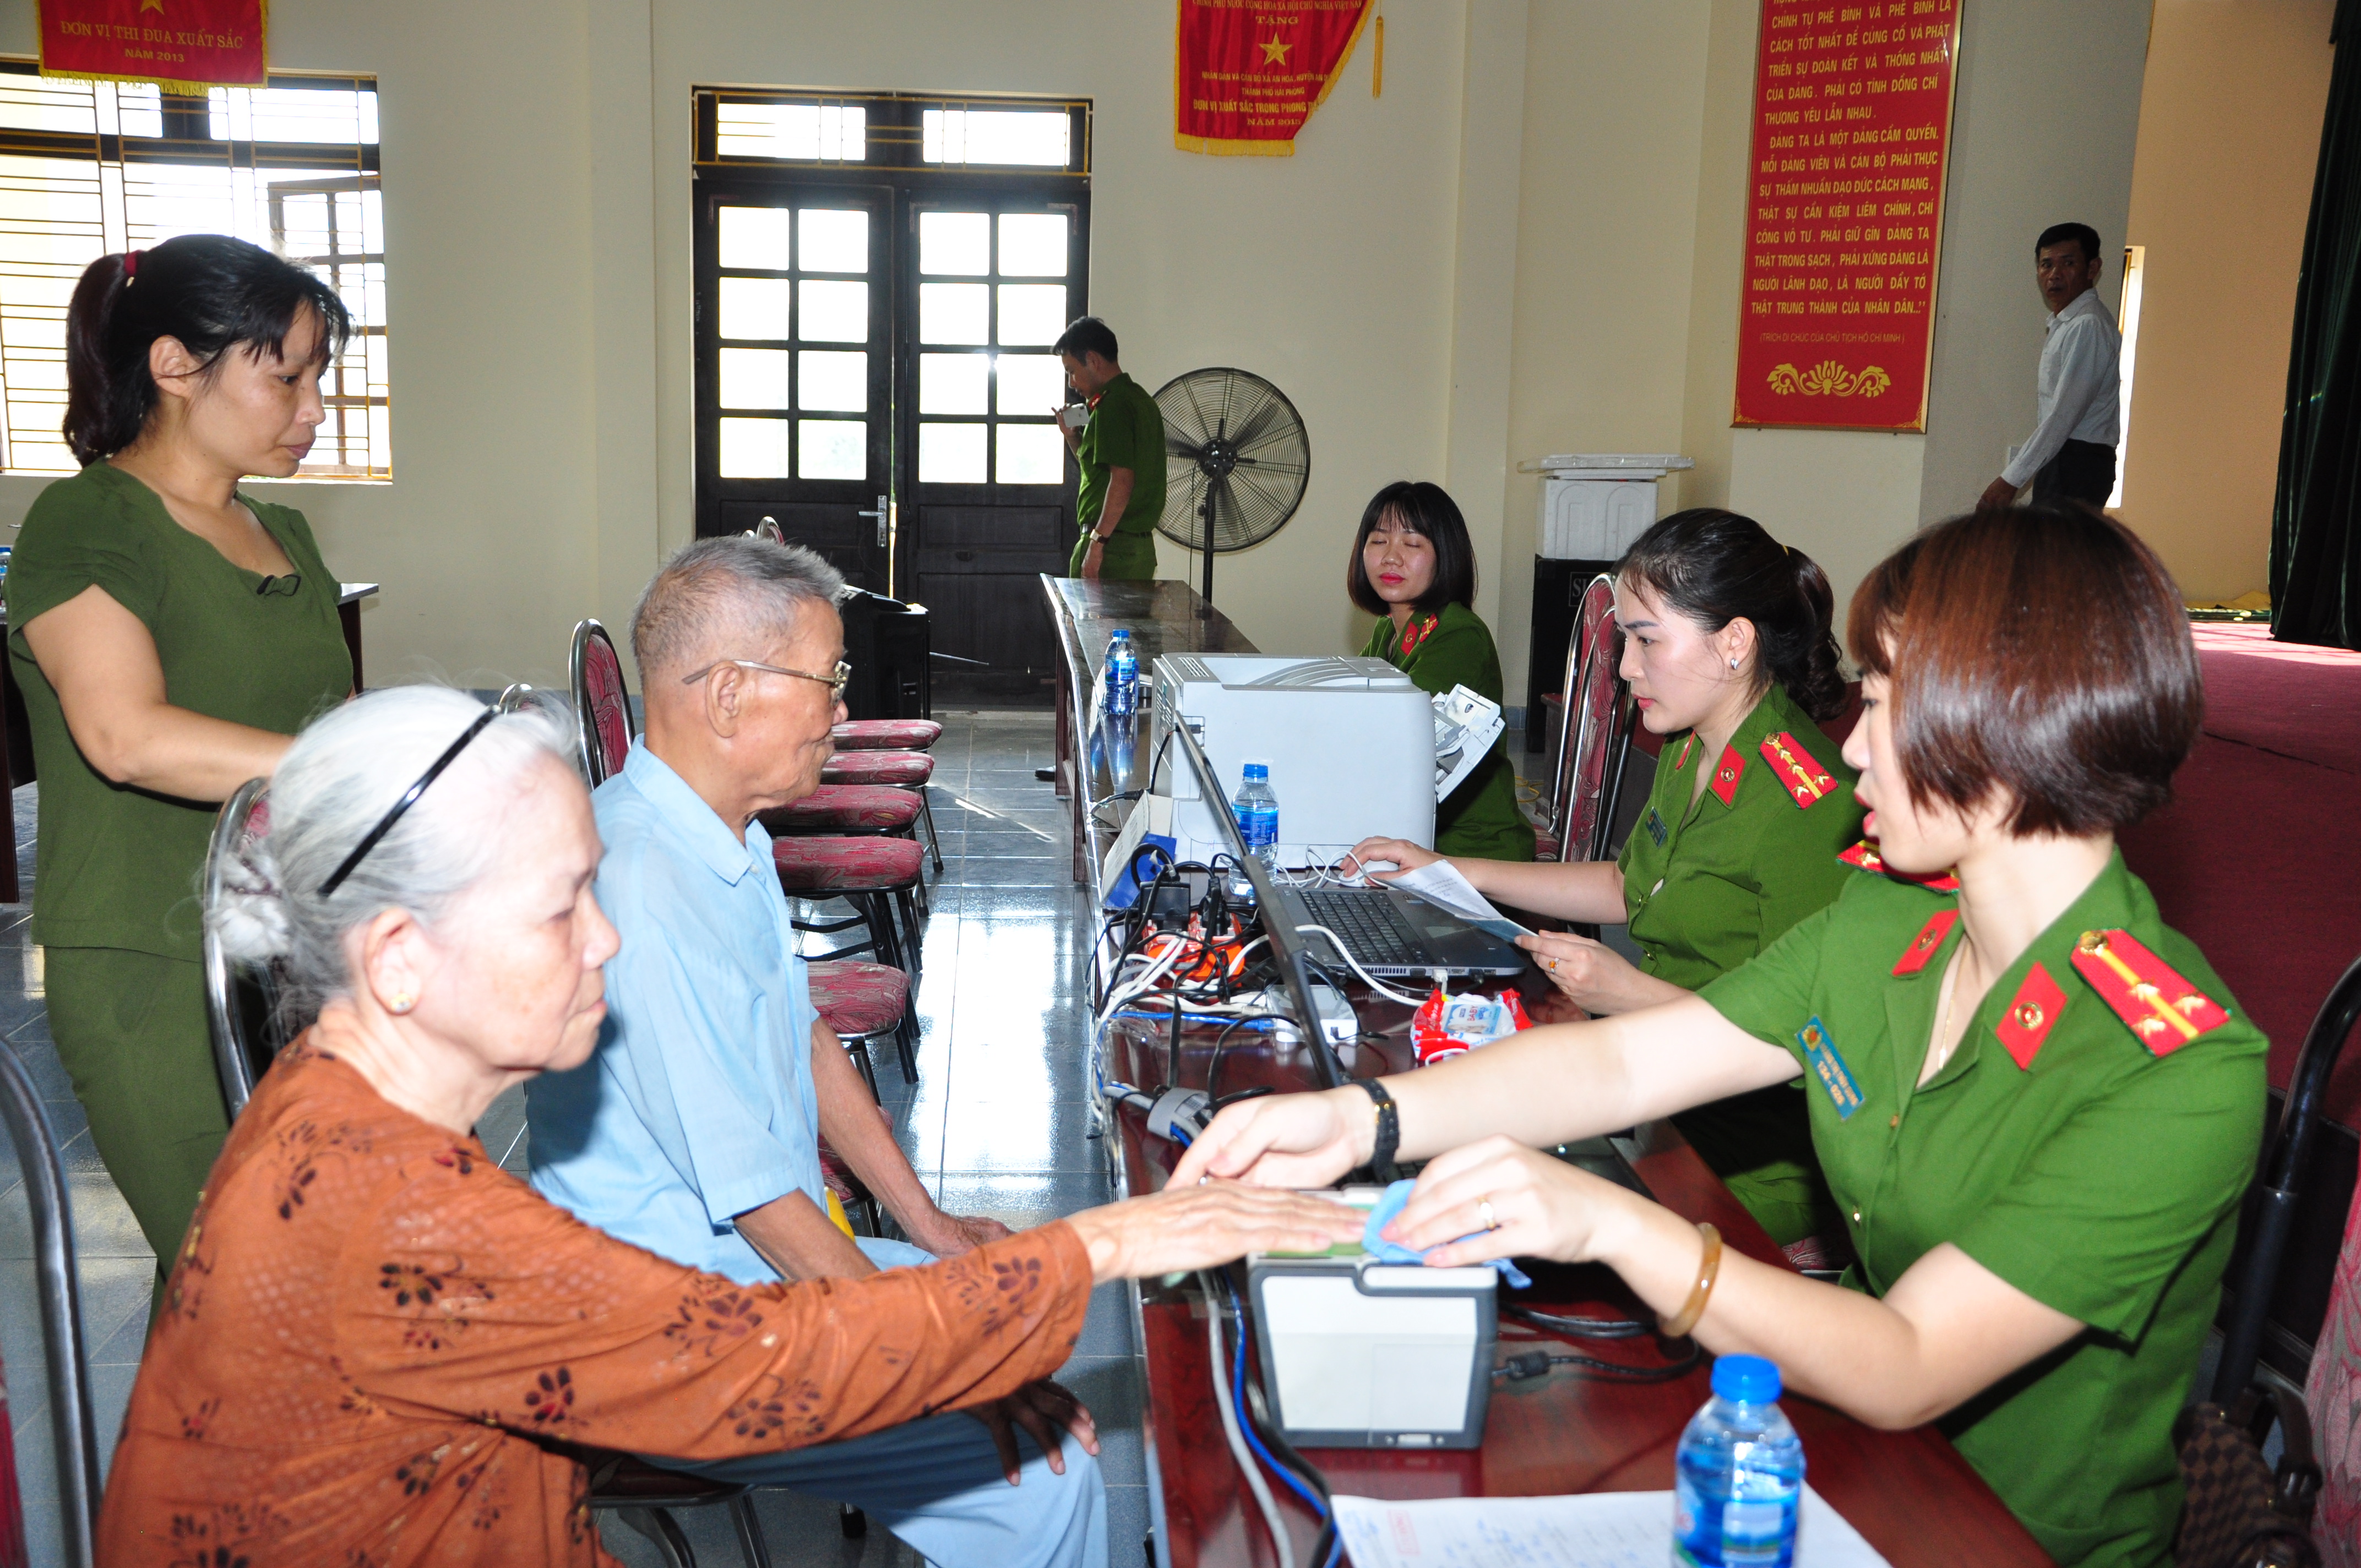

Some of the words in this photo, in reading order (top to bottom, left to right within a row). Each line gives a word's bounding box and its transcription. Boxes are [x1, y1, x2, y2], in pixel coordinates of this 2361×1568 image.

[1255, 15, 1299, 25] TẶNG
[1772, 10, 1797, 28] CHỈNH
[1803, 12, 1814, 29] TỰ
[1818, 7, 1834, 24] PHÊ
[1841, 6, 1861, 21] BÌNH
[1869, 3, 1880, 18] VÀ
[95, 24, 110, 40] VỊ
[114, 26, 139, 40] THI
[144, 29, 172, 43] ĐUA
[177, 29, 214, 47] XUẤT
[1771, 37, 1793, 52] CÁCH
[1798, 32, 1814, 50] TỐT
[1819, 30, 1842, 48] NHẤT
[1846, 27, 1858, 46] ĐỂ
[1863, 26, 1887, 44] CỦNG
[1893, 23, 1906, 41] CỐ
[1911, 23, 1922, 40] VÀ
[1925, 20, 1951, 39] PHÁT
[124, 48, 153, 59] NĂM
[156, 52, 184, 62] 2013
[1769, 56, 1791, 76] TRIỂN
[1797, 61, 1808, 78] SỰ
[1812, 57, 1837, 73] ĐOÀN
[1842, 53, 1858, 70] KẾT
[1866, 53, 1877, 68] VÀ
[1885, 48, 1916, 67] THỐNG
[1921, 44, 1946, 65] NHẤT
[1767, 83, 1783, 101] CỦA
[1825, 82, 1845, 96] PHẢI
[1850, 79, 1862, 95] CÓ
[1867, 78, 1886, 93] TÌNH
[1891, 73, 1917, 91] ĐỒNG
[1922, 72, 1939, 90] CHÍ
[1255, 102, 1279, 113] TRONG
[1765, 111, 1799, 124] THƯƠNG
[1804, 107, 1820, 122] YÊU
[1825, 102, 1842, 121] LẪN
[1770, 131, 1794, 148] ĐẢNG
[1799, 134, 1809, 146] TA
[1814, 130, 1825, 146] LÀ
[1830, 129, 1848, 148] MỘT
[1853, 126, 1878, 144] ĐẢNG
[1881, 124, 1901, 142] CẦM
[1761, 156, 1777, 172] MỖI
[1781, 155, 1805, 172] ĐẢNG
[1810, 155, 1829, 170] VIÊN
[1835, 154, 1846, 169] VÀ
[1851, 153, 1869, 168] CÁN
[1874, 151, 1886, 171] BỘ
[1891, 148, 1912, 166] PHẢI
[1914, 150, 1938, 168] THỰC
[1760, 183, 1771, 199] SỰ
[1776, 180, 1799, 195] THẤM
[1834, 181, 1852, 197] ĐẠO
[1854, 177, 1873, 193] ĐỨC
[1875, 176, 1899, 192] CÁCH
[1759, 205, 1779, 222] THẬT
[1786, 206, 1798, 222] SỰ
[1829, 202, 1849, 221] KIỆM
[1857, 201, 1876, 217] LIÊM
[1918, 198, 1934, 215] CHÍ
[1756, 228, 1779, 243] CÔNG
[1785, 227, 1796, 243] VÔ
[1821, 225, 1840, 242] PHẢI
[1845, 226, 1861, 242] GIỮ
[1865, 225, 1880, 241] GÌN
[1887, 222, 1913, 241] ĐẢNG
[1918, 227, 1929, 239] TA
[1755, 252, 1776, 270] THẬT
[1778, 254, 1805, 266] TRONG
[1840, 248, 1860, 265] PHẢI
[1862, 249, 1887, 265] XỨNG
[1889, 249, 1915, 265] ĐÁNG
[1917, 248, 1928, 264] LÀ
[1753, 275, 1778, 291] NGƯỜI
[1837, 275, 1848, 290] LÀ
[1856, 274, 1883, 290] NGƯỜI
[1914, 273, 1926, 289] TỚ
[1752, 299, 1772, 317] THẬT
[1777, 302, 1804, 314] TRUNG
[1809, 299, 1837, 313] THÀNH
[1842, 296, 1859, 314] CỦA
[1865, 298, 1890, 313] NHÂN
